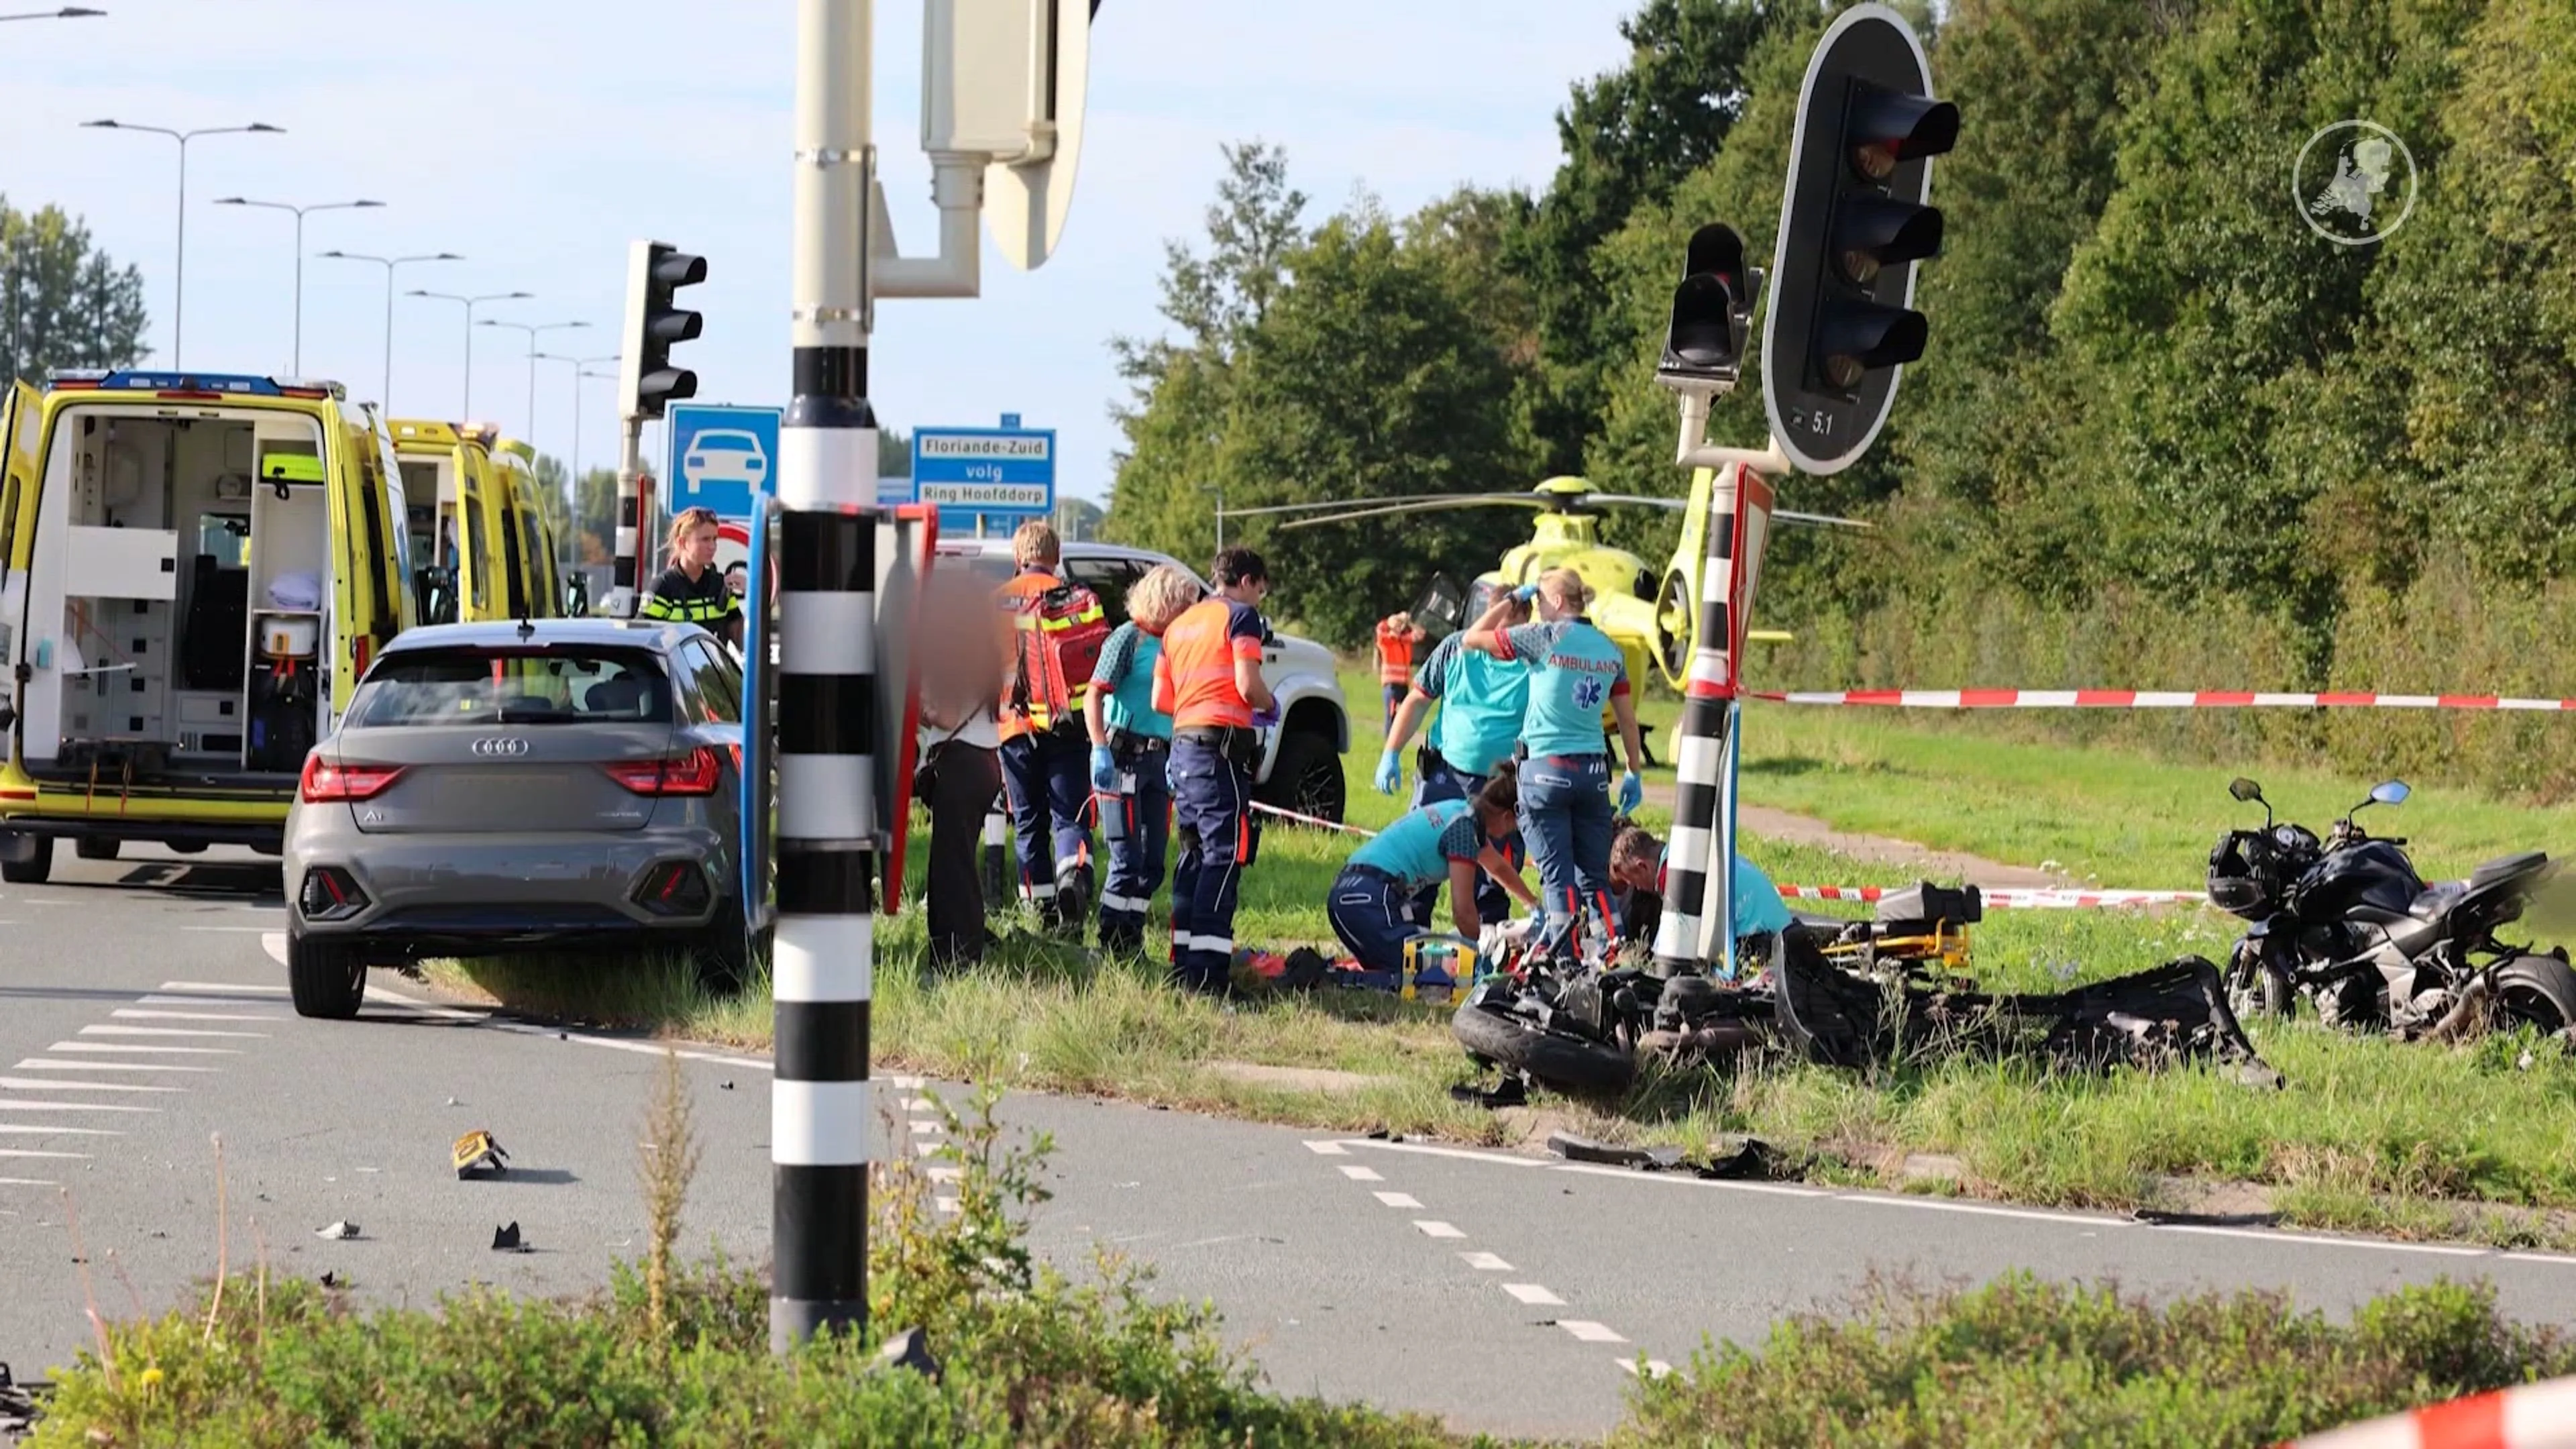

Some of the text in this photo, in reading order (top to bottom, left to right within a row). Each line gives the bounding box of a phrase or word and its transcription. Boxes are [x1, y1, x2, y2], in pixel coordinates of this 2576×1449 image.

[1812, 410, 1833, 436] 5.1
[926, 439, 1042, 453] Floriande-Zuid
[966, 463, 1003, 482] volg
[924, 486, 1042, 503] Ring Hoofddorp
[1548, 653, 1620, 674] AMBULANC
